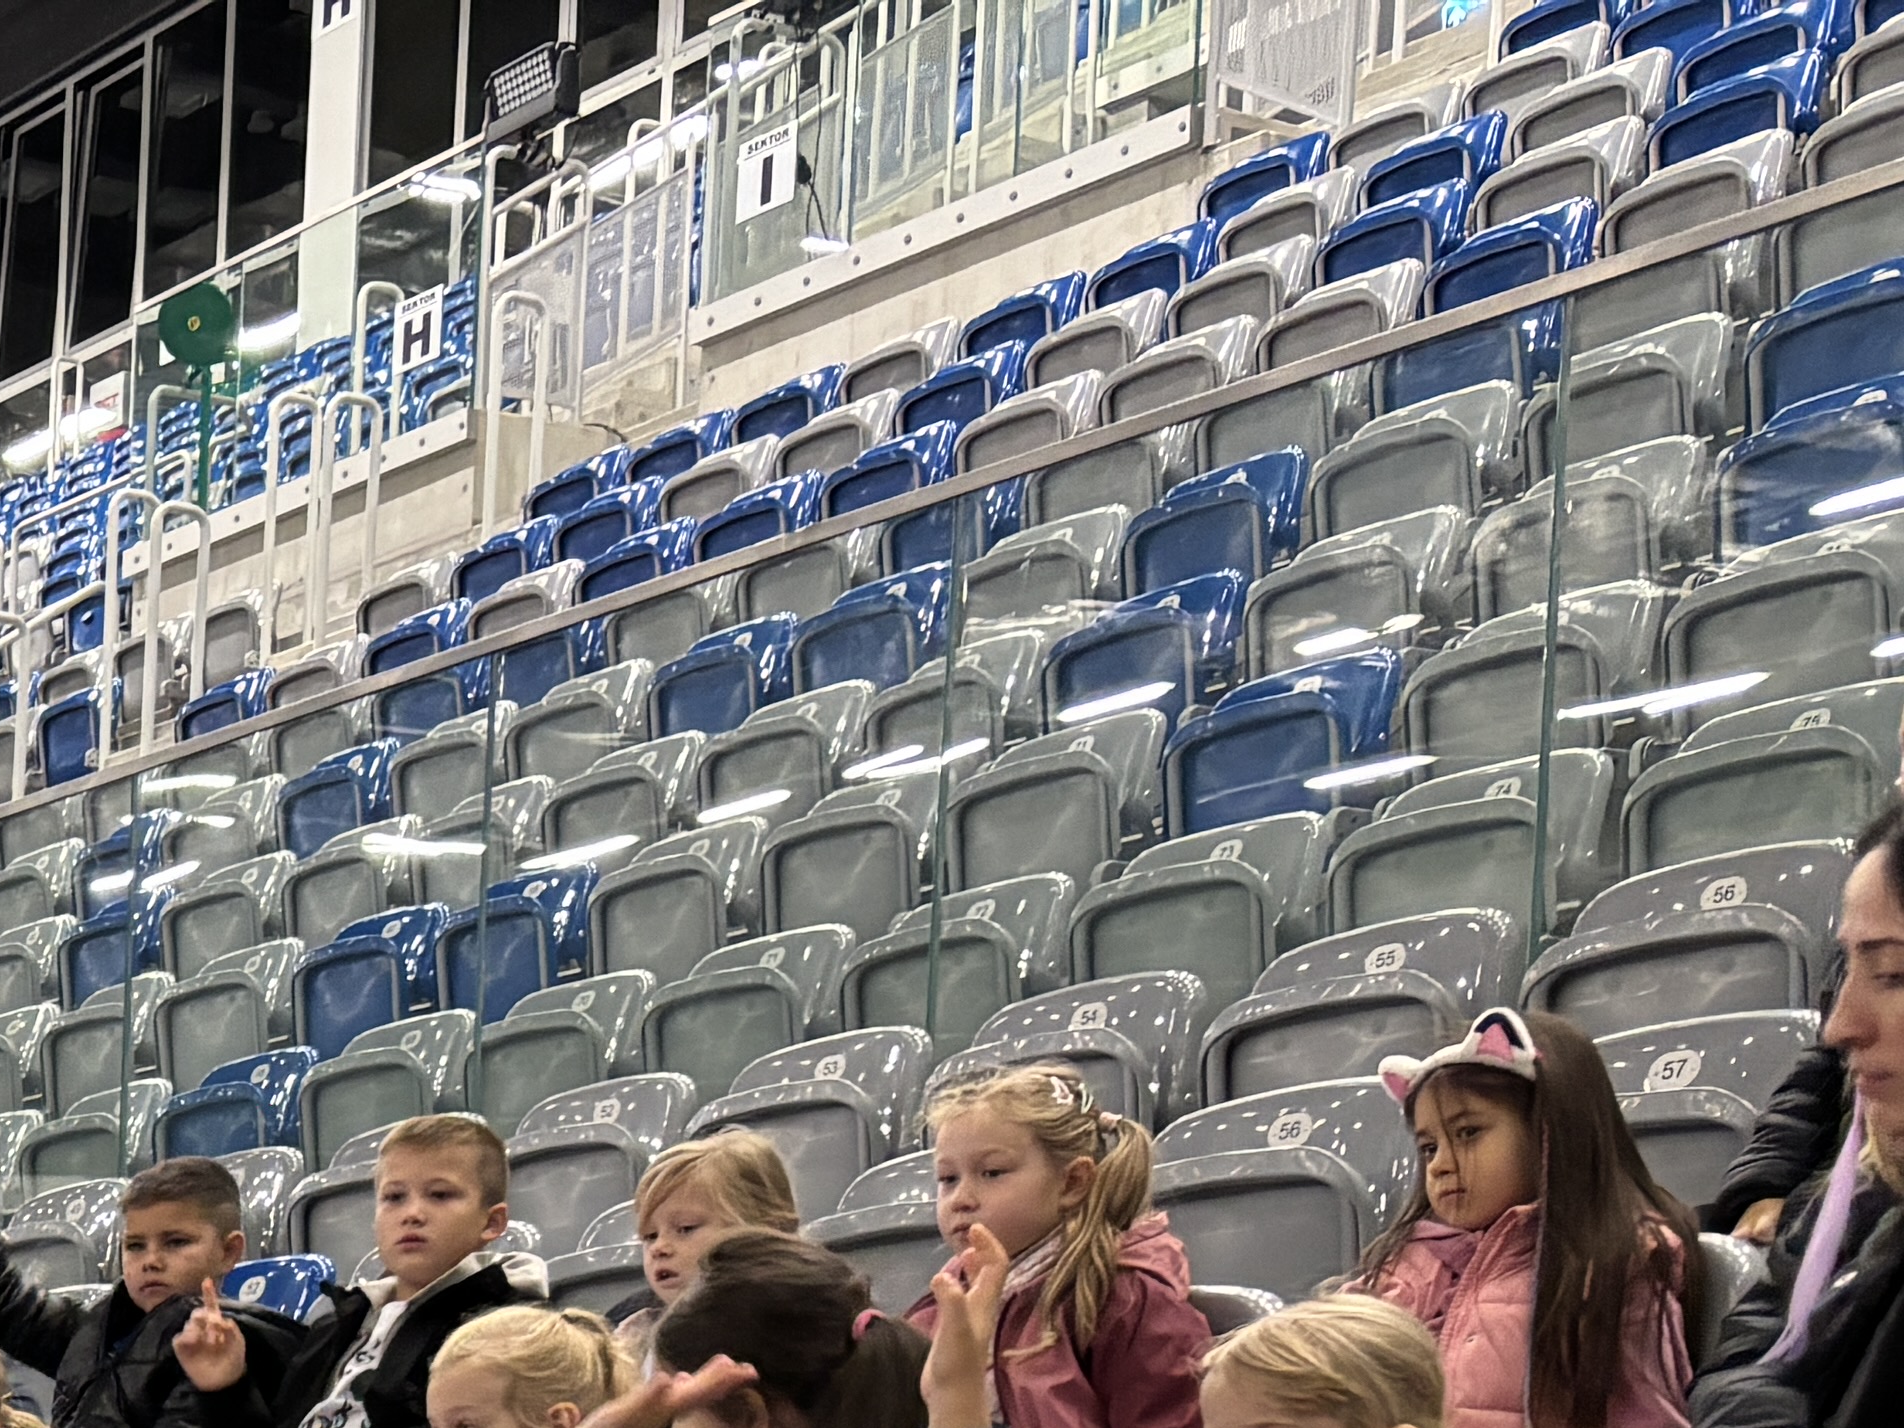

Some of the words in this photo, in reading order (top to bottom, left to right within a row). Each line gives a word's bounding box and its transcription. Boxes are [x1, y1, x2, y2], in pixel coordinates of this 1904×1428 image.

[747, 127, 790, 155] SEKTOR
[760, 153, 774, 207] I
[401, 292, 436, 315] SEKTOR
[402, 311, 432, 366] H
[1494, 781, 1513, 796] 74
[1712, 884, 1737, 904] 56
[1373, 949, 1397, 968] 55
[1080, 1010, 1098, 1026] 54
[822, 1061, 840, 1076] 53
[1660, 1057, 1690, 1081] 57
[600, 1104, 616, 1118] 52
[1278, 1119, 1302, 1141] 56
